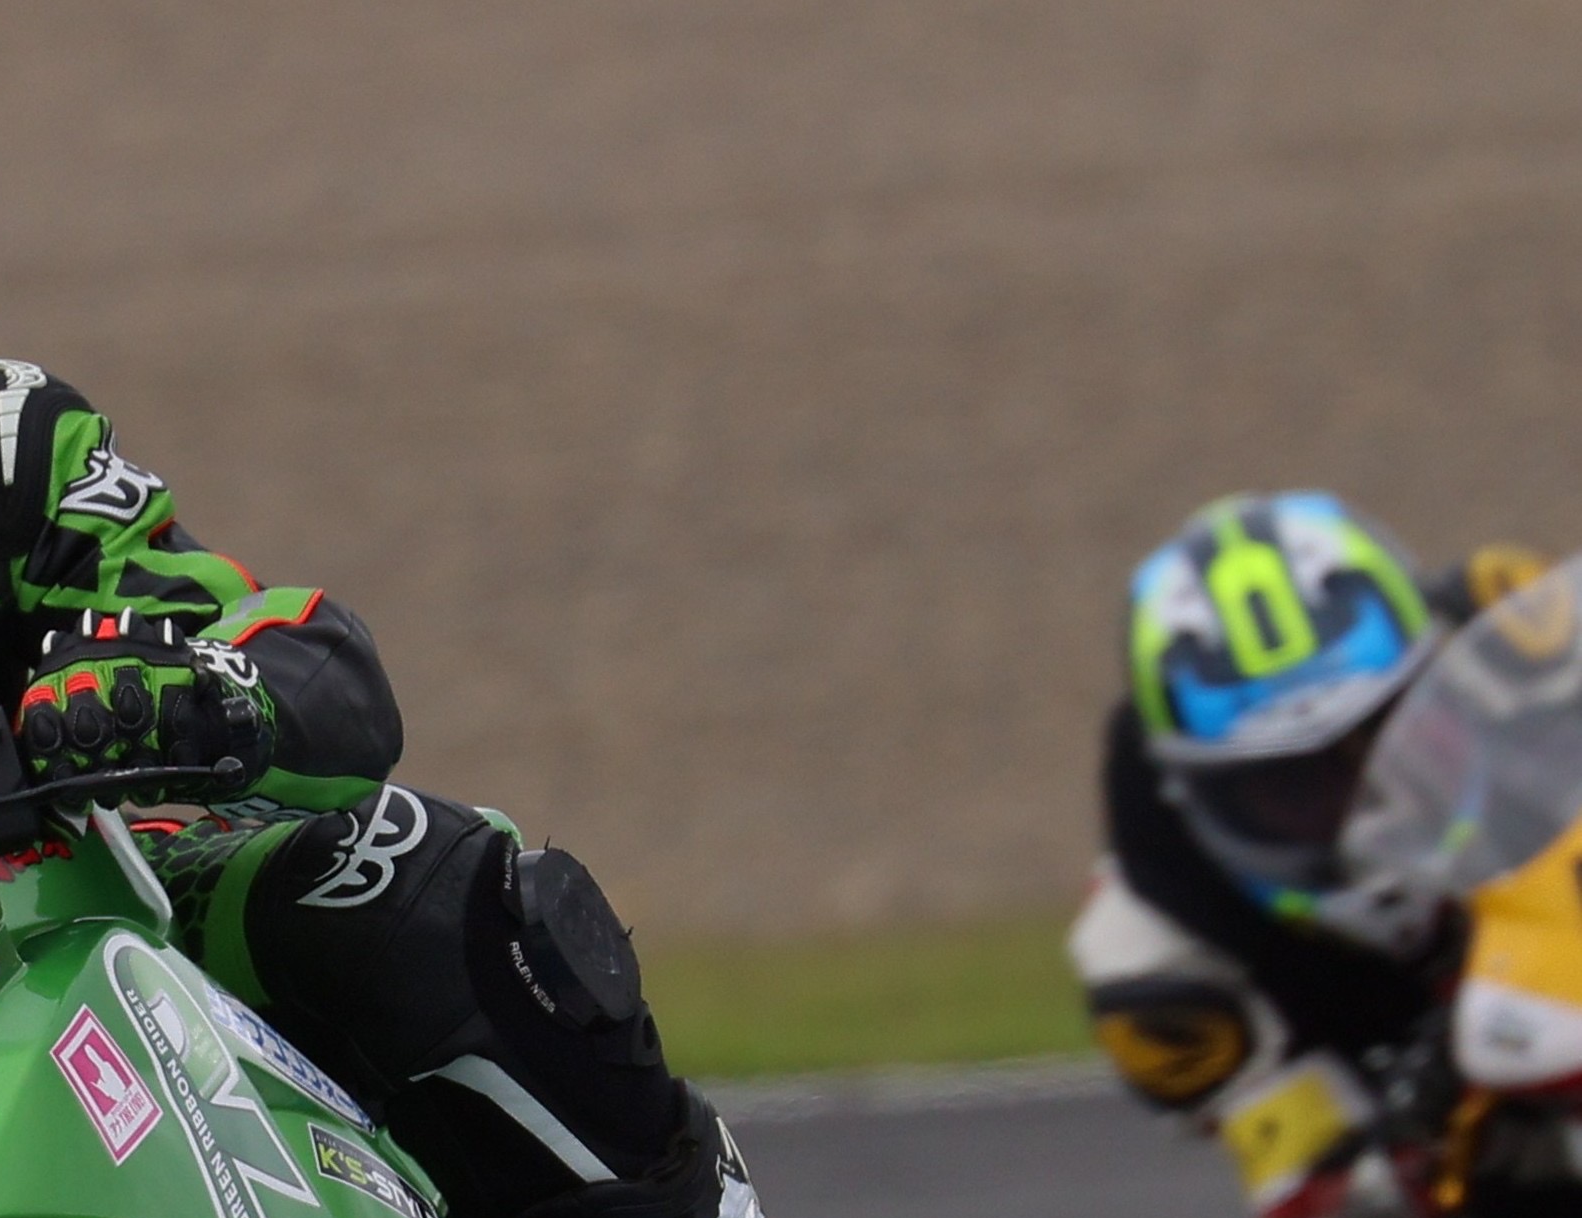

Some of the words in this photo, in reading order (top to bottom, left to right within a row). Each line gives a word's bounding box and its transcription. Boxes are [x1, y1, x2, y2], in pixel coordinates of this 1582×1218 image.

[510, 941, 532, 983] ARLEN
[530, 983, 556, 1013] NESS
[126, 988, 169, 1055] RIDER
[166, 1057, 216, 1152] RIBBON
